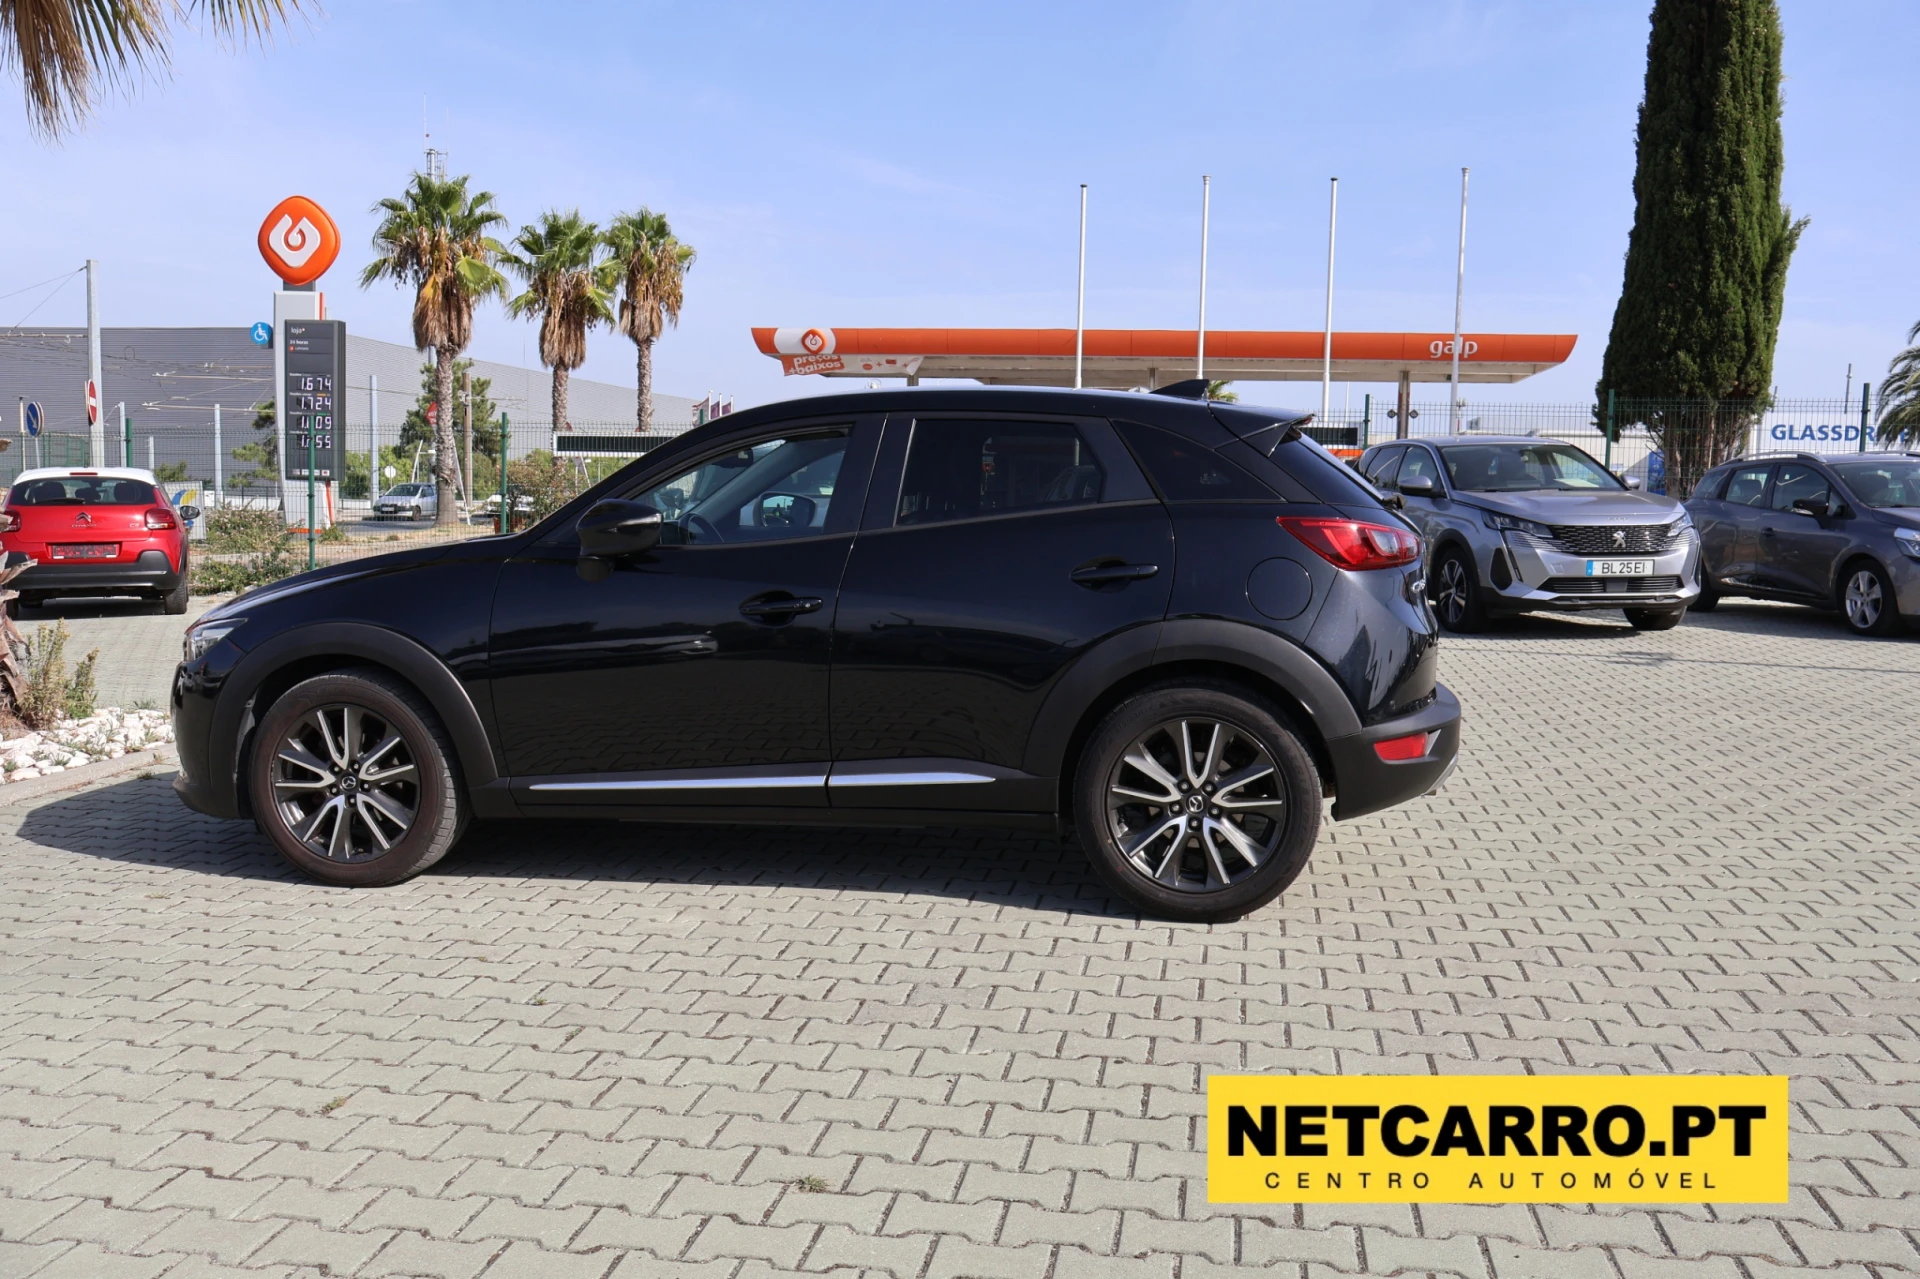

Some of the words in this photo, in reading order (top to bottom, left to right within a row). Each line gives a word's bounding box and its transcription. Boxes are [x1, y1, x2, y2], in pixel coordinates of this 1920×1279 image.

[1429, 337, 1478, 359] galp
[301, 377, 332, 391] 1.674
[301, 396, 332, 410] 1.724
[1771, 424, 1911, 443] GLASSDR
